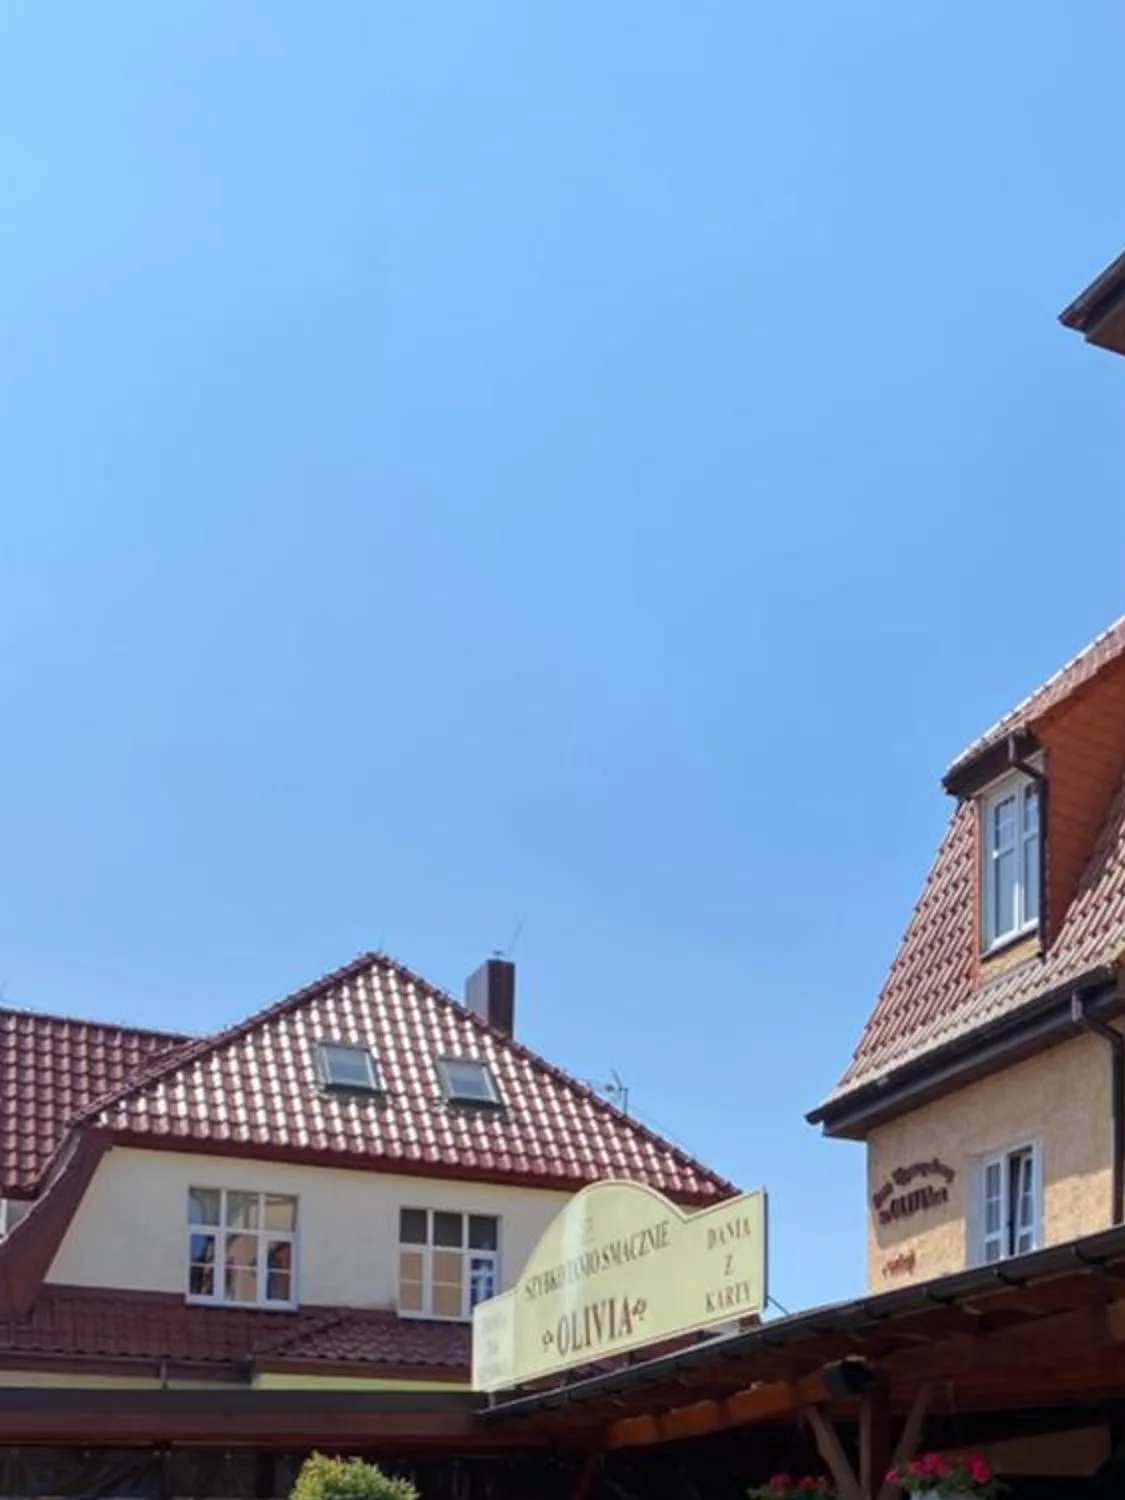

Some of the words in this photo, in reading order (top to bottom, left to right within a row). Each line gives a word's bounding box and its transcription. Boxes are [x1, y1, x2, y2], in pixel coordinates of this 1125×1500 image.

[601, 1220, 672, 1271] SMACZNIE
[707, 1216, 750, 1250] DANIA
[723, 1253, 735, 1276] Z
[706, 1281, 750, 1313] KARTY
[557, 1293, 633, 1356] OLIVIA
